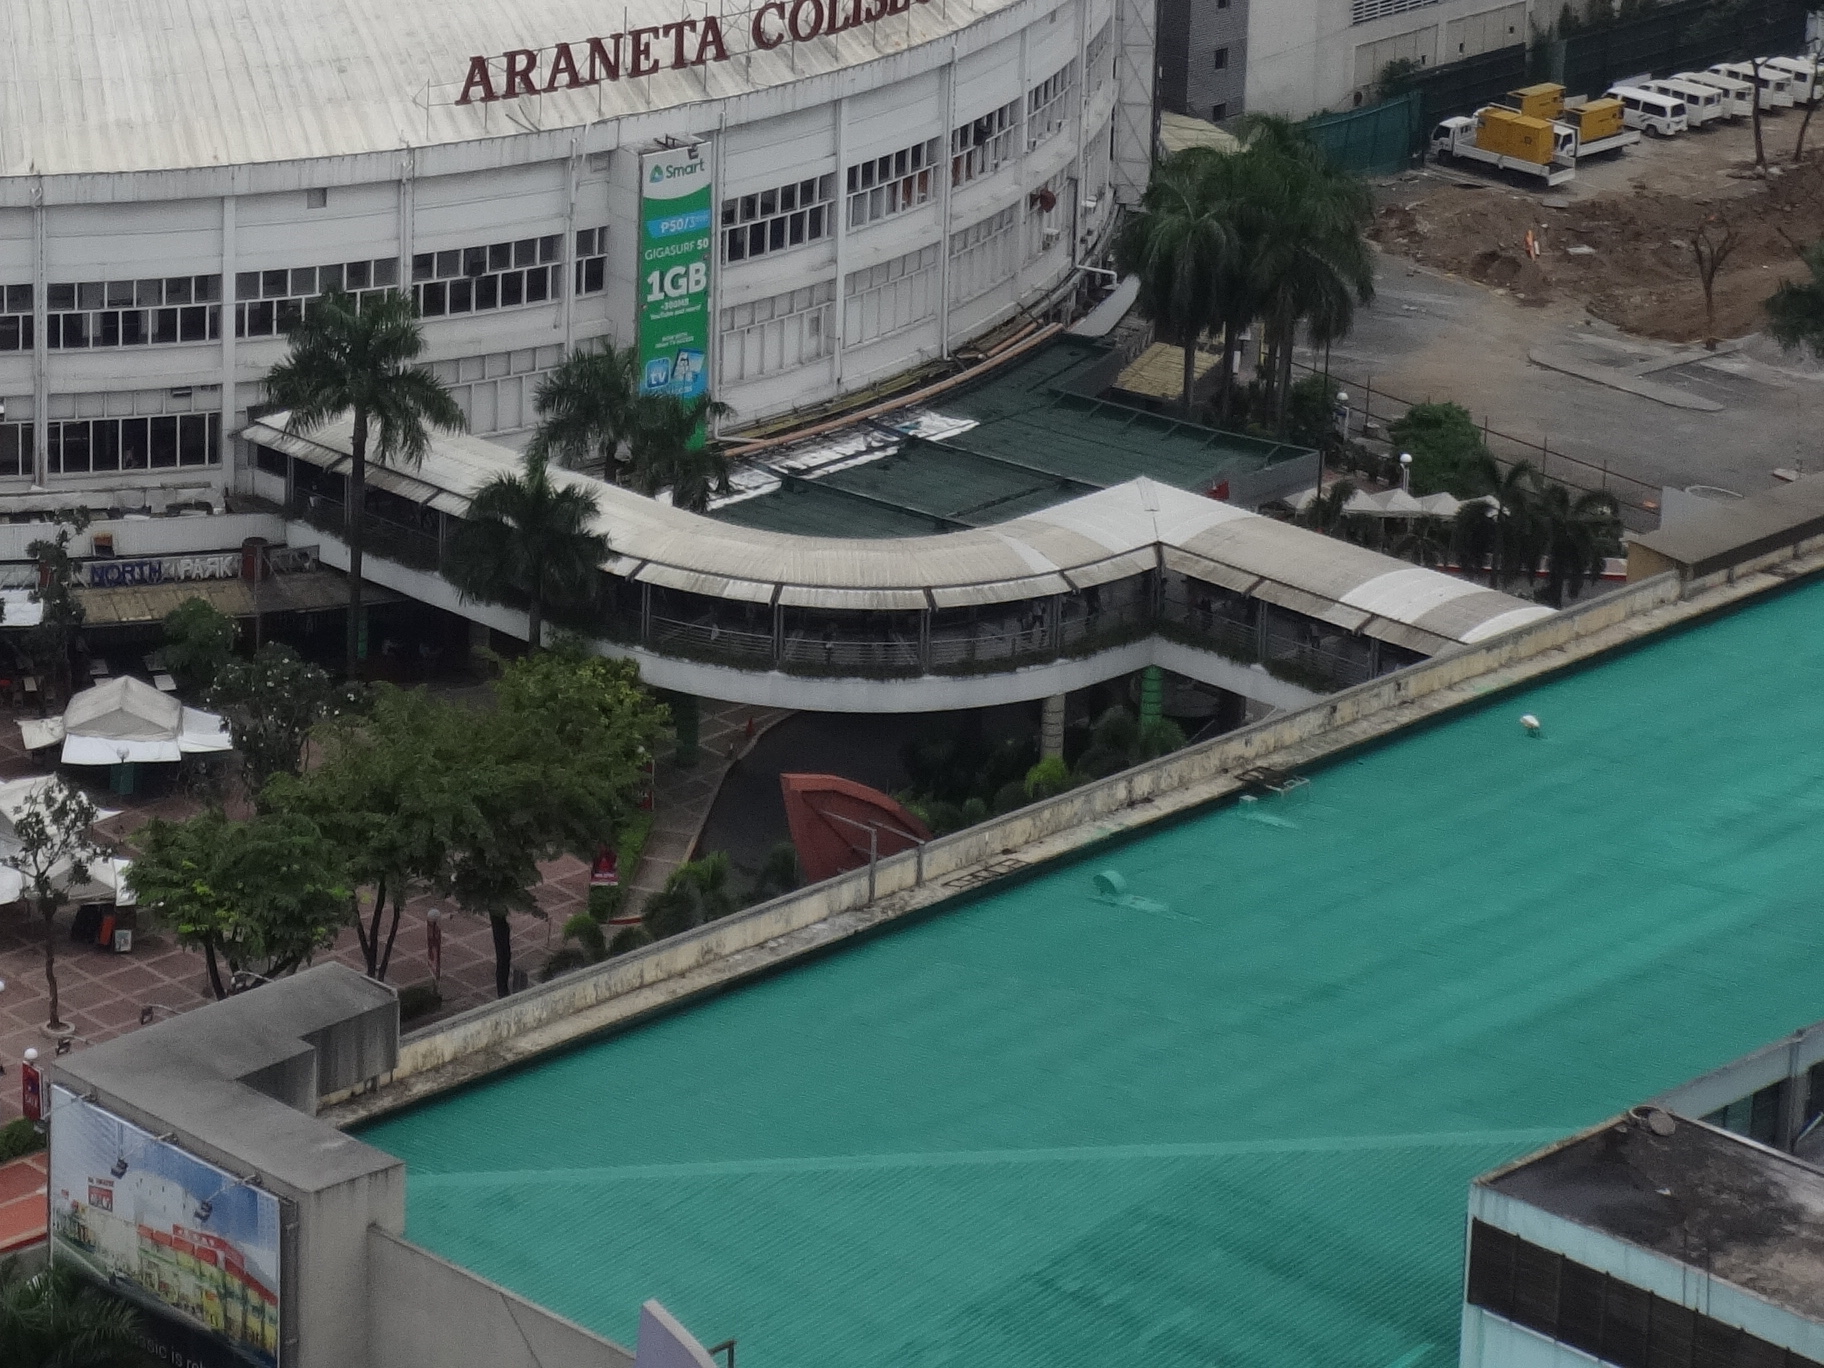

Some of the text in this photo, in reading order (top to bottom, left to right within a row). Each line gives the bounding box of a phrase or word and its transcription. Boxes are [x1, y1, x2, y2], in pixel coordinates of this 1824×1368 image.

[455, 16, 730, 106] ARANETA
[666, 158, 705, 179] Smart
[645, 237, 709, 261] GIGASURF 50
[647, 261, 707, 302] 1GB
[91, 560, 163, 587] NORTH
